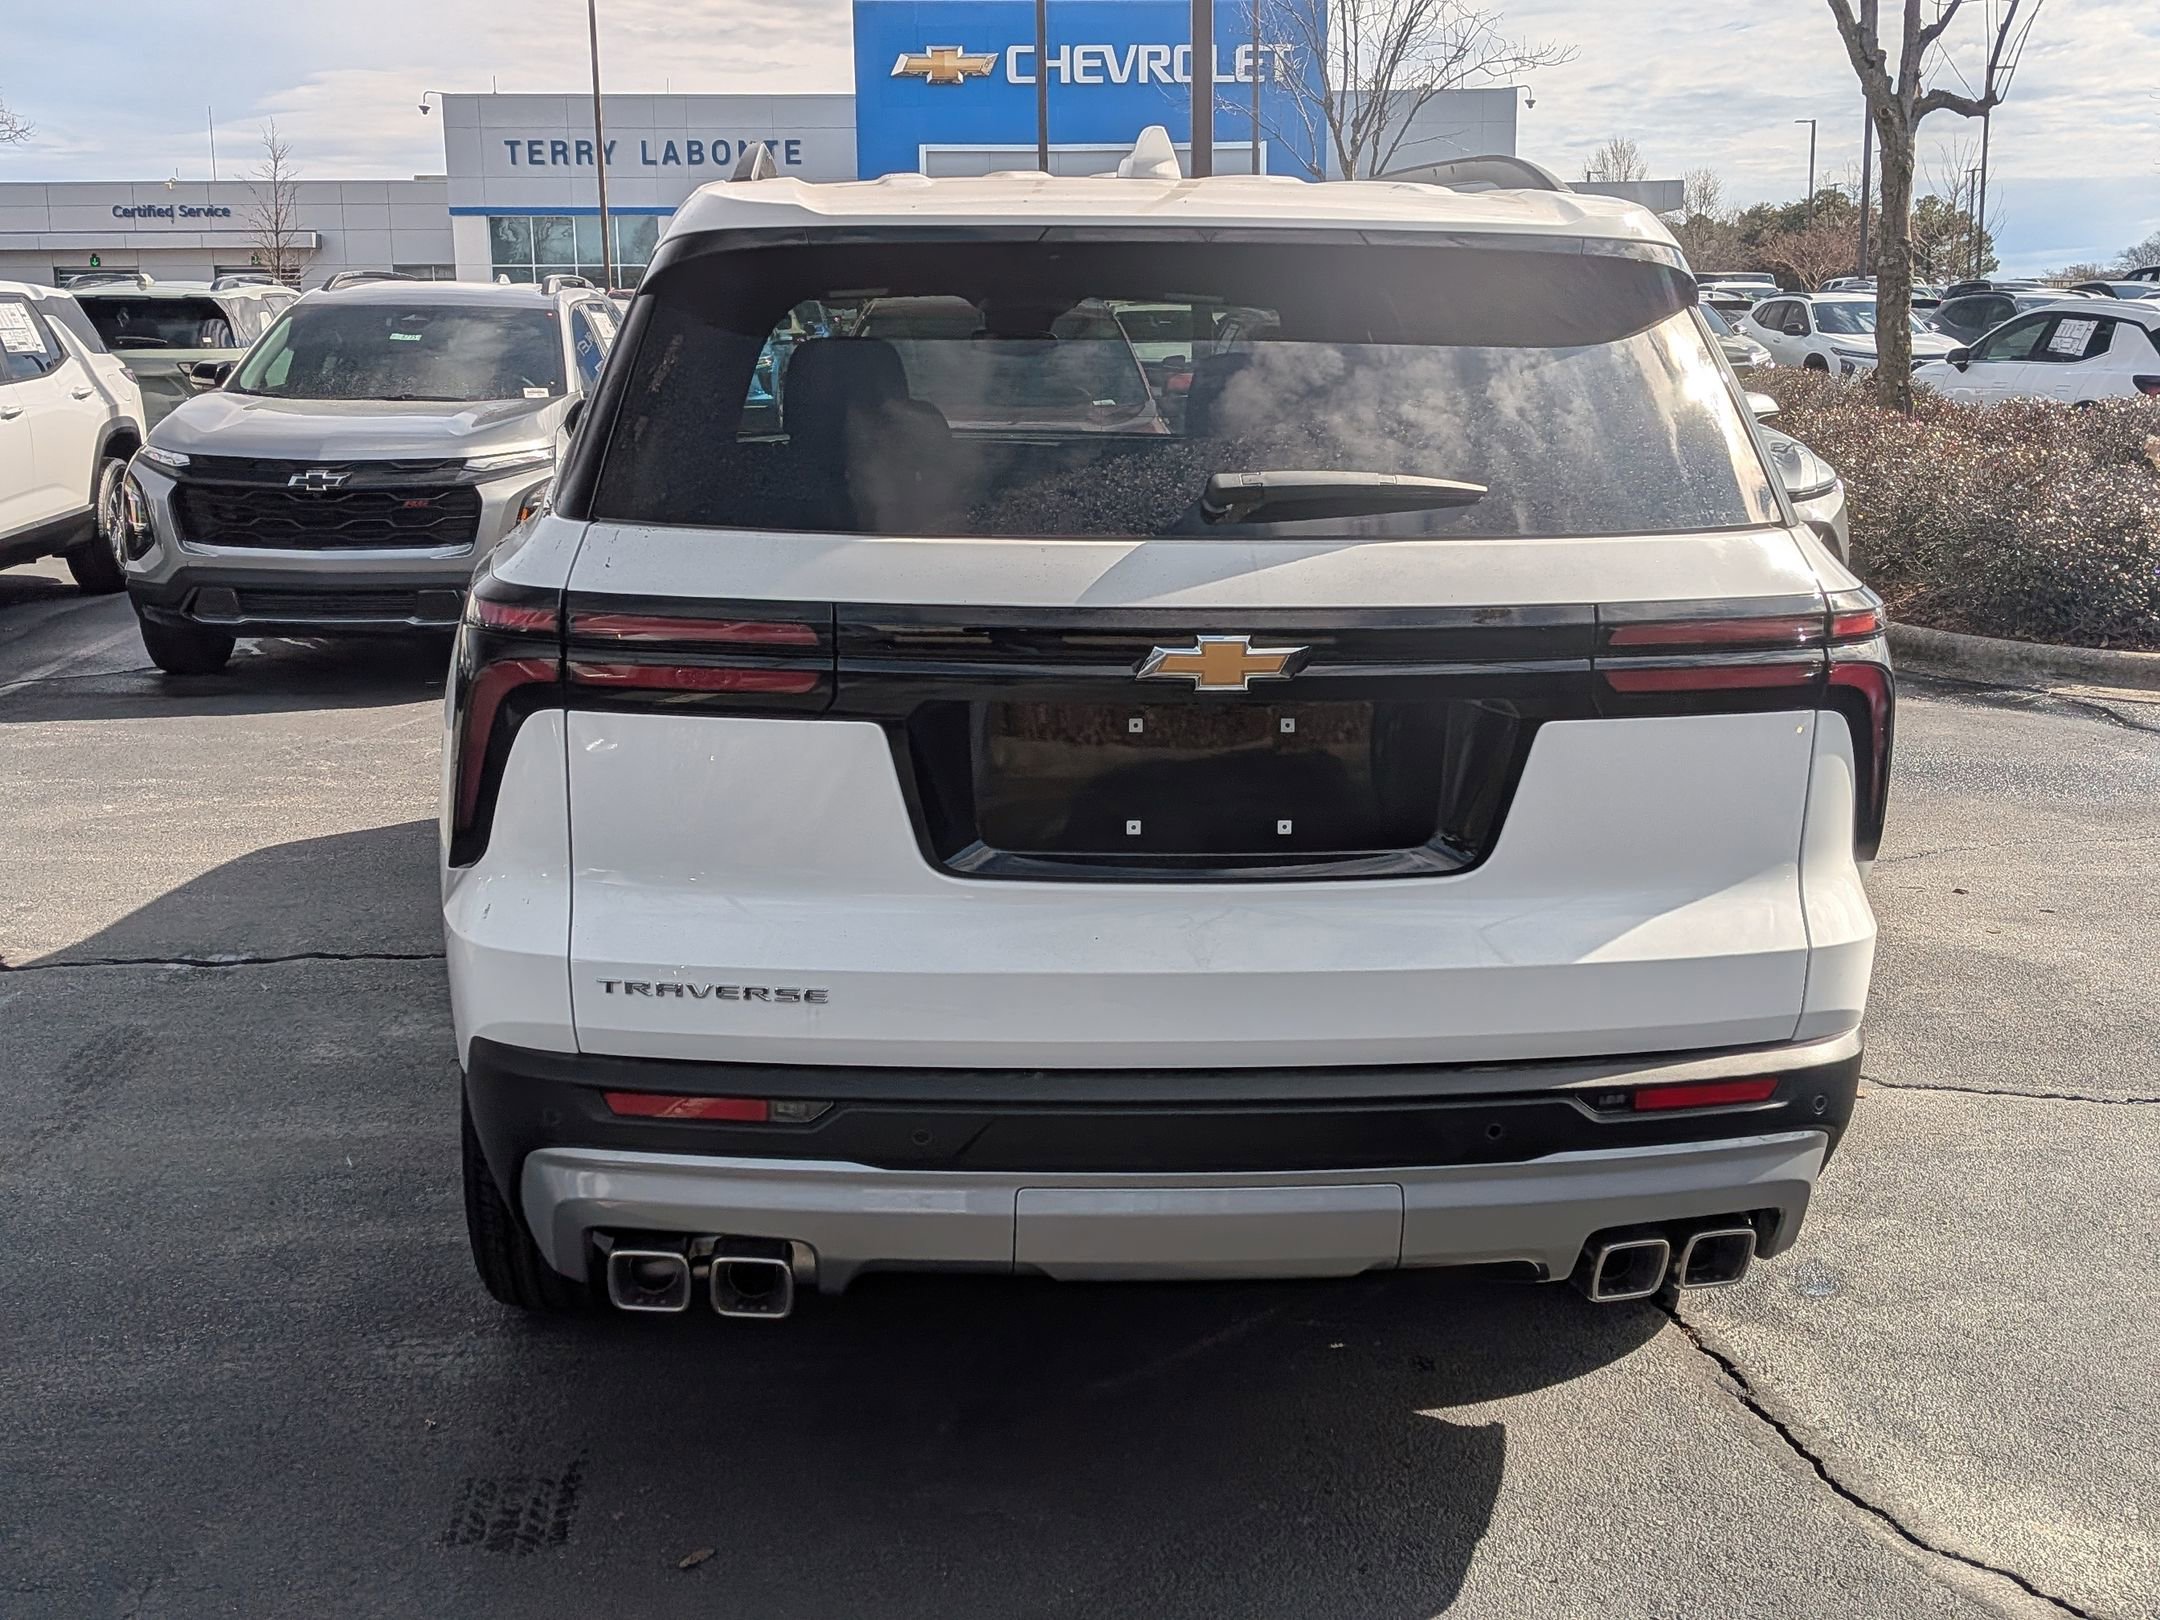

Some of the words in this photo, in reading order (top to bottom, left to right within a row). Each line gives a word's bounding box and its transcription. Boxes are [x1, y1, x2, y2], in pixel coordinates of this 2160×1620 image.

[504, 140, 616, 166] TERRY
[112, 205, 174, 217] Certified
[179, 205, 231, 217] Service
[597, 979, 829, 1004] TRAVERSE
